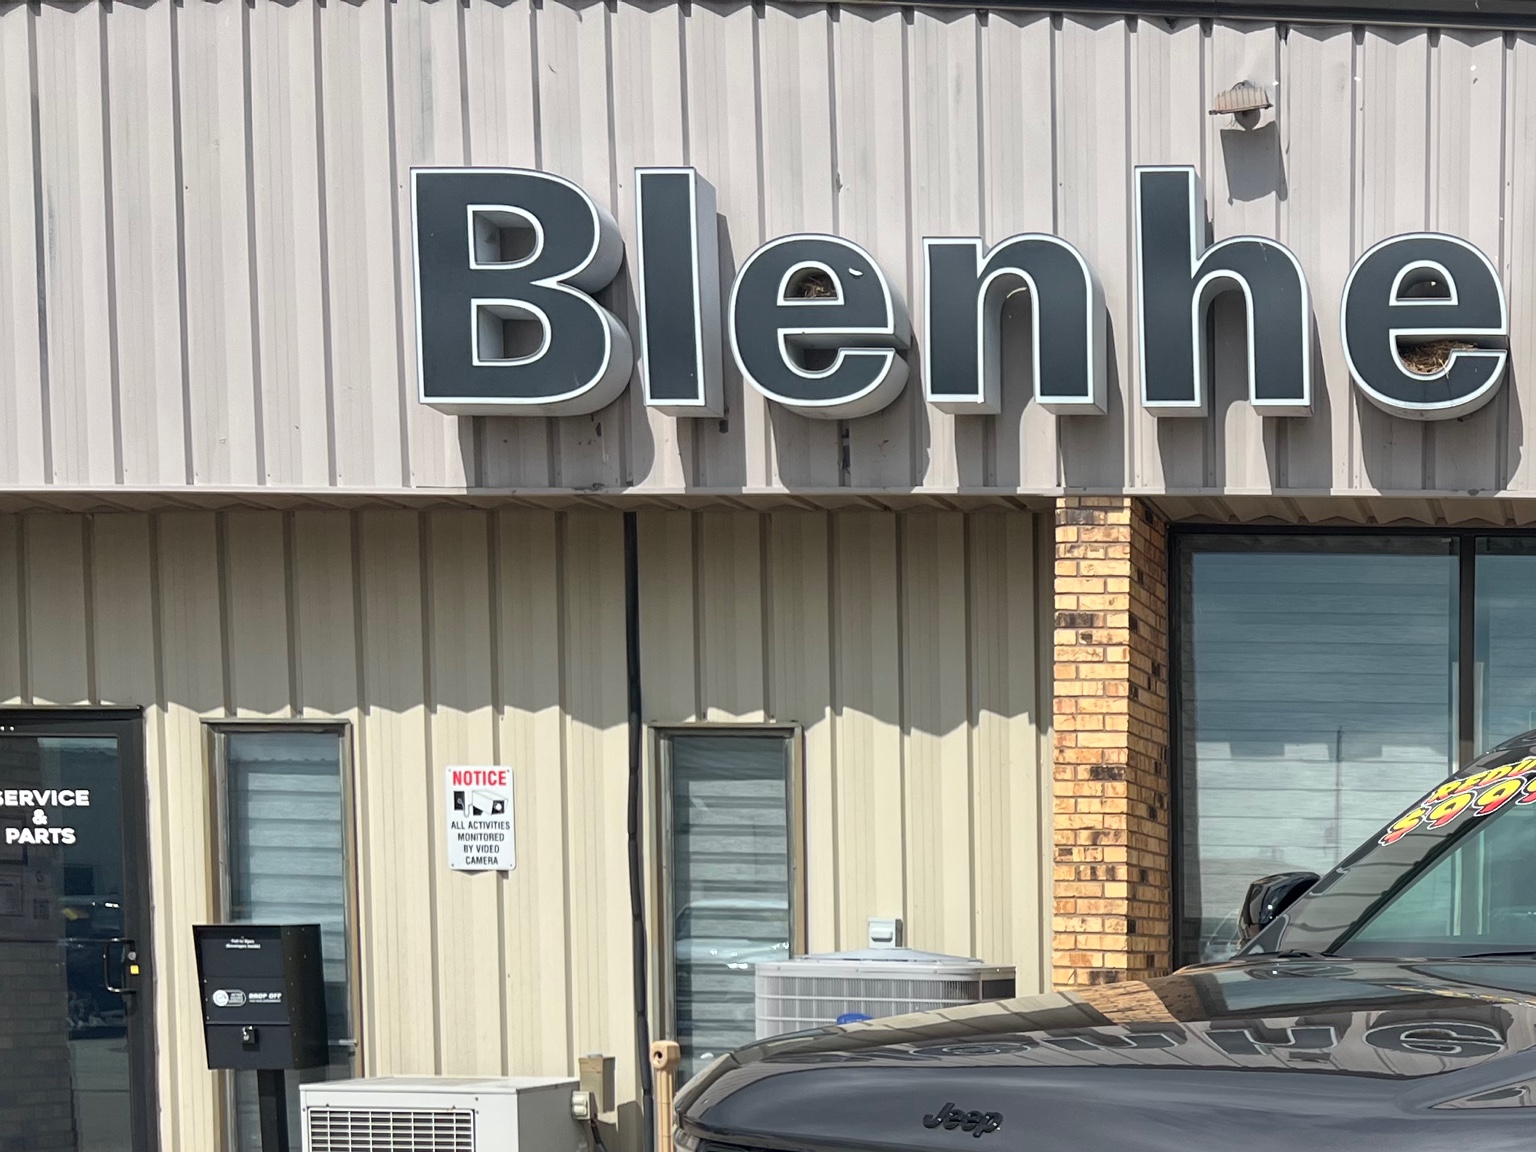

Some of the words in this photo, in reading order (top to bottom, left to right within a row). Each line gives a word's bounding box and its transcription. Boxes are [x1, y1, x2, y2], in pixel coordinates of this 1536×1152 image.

[452, 770, 507, 787] NOTICE
[32, 808, 48, 825] &
[451, 820, 465, 830] ALL
[468, 821, 511, 831] ACTIVITIES
[5, 827, 77, 845] PARTS
[457, 832, 505, 842] MONITORED
[463, 844, 474, 854] BY
[476, 844, 500, 854] VIDEO
[465, 856, 499, 866] CAMERA
[922, 1102, 1004, 1138] Jeep
